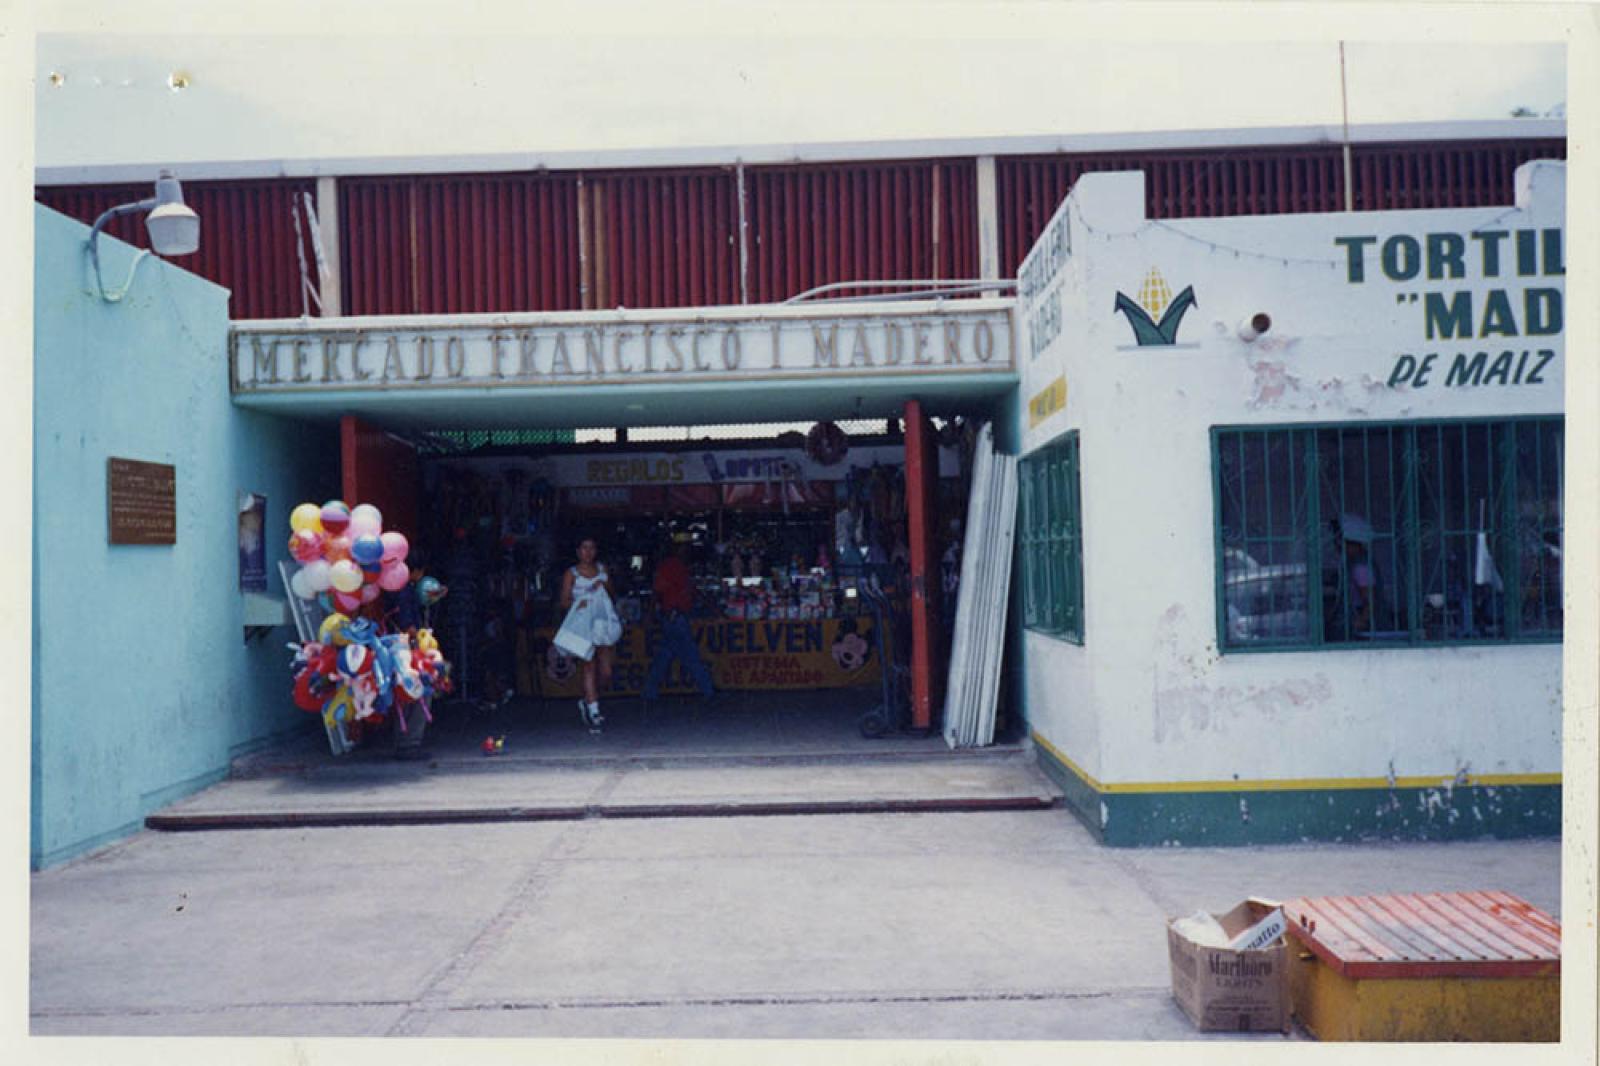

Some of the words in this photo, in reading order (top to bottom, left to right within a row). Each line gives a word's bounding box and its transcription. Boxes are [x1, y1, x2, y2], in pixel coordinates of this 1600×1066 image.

[248, 333, 465, 385] MERCADO
[488, 324, 742, 380] FRANCISCO
[769, 323, 782, 369] I
[810, 319, 996, 368] MADERO
[1386, 353, 1438, 388] DE
[1444, 349, 1555, 387] MAIZ
[587, 459, 685, 482] REGALOS
[1208, 951, 1273, 977] Marlboro
